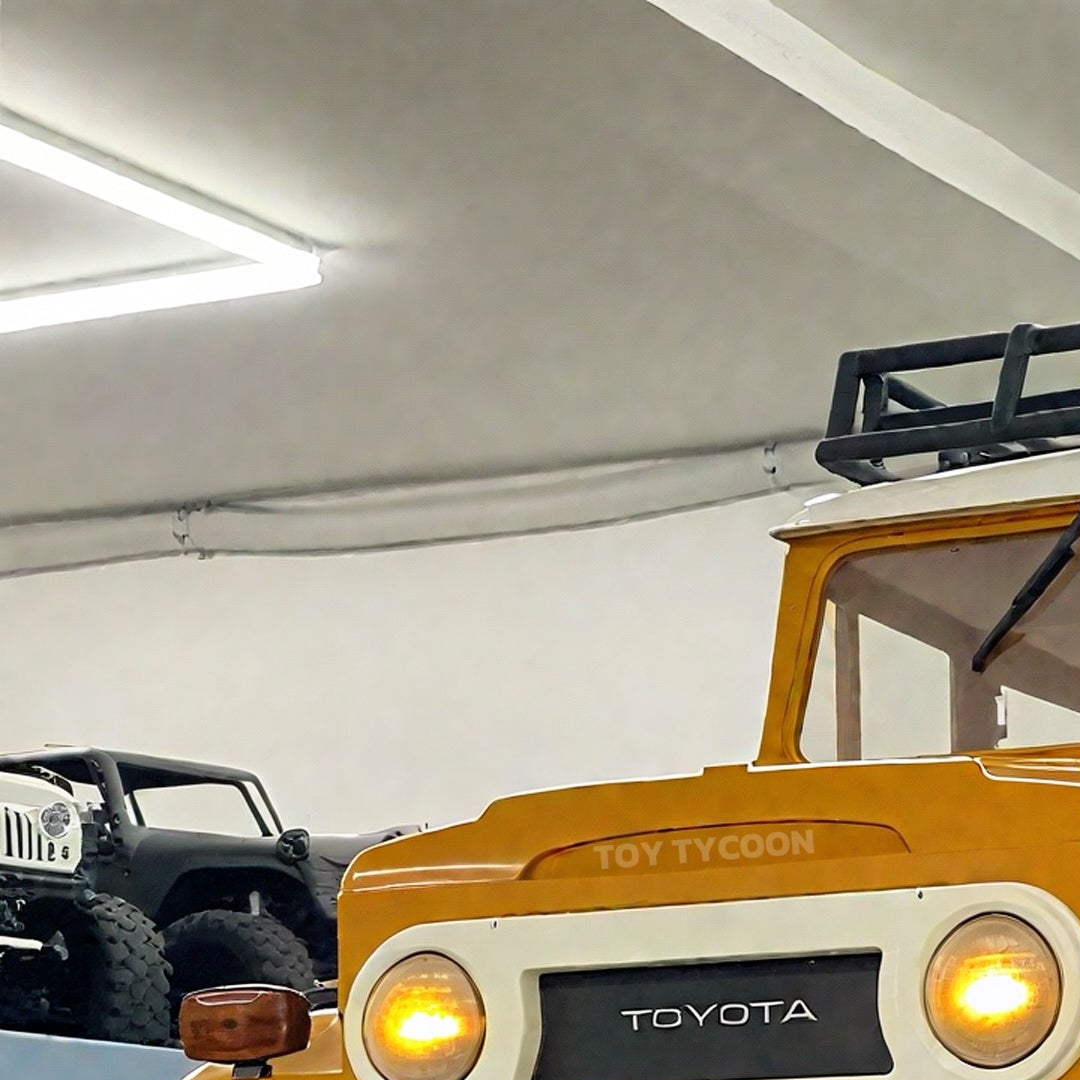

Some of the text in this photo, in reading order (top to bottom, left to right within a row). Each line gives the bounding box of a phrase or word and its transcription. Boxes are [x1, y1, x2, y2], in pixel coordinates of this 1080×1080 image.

[593, 829, 815, 870] TOY TYCOON
[620, 999, 818, 1032] TOYOTA
